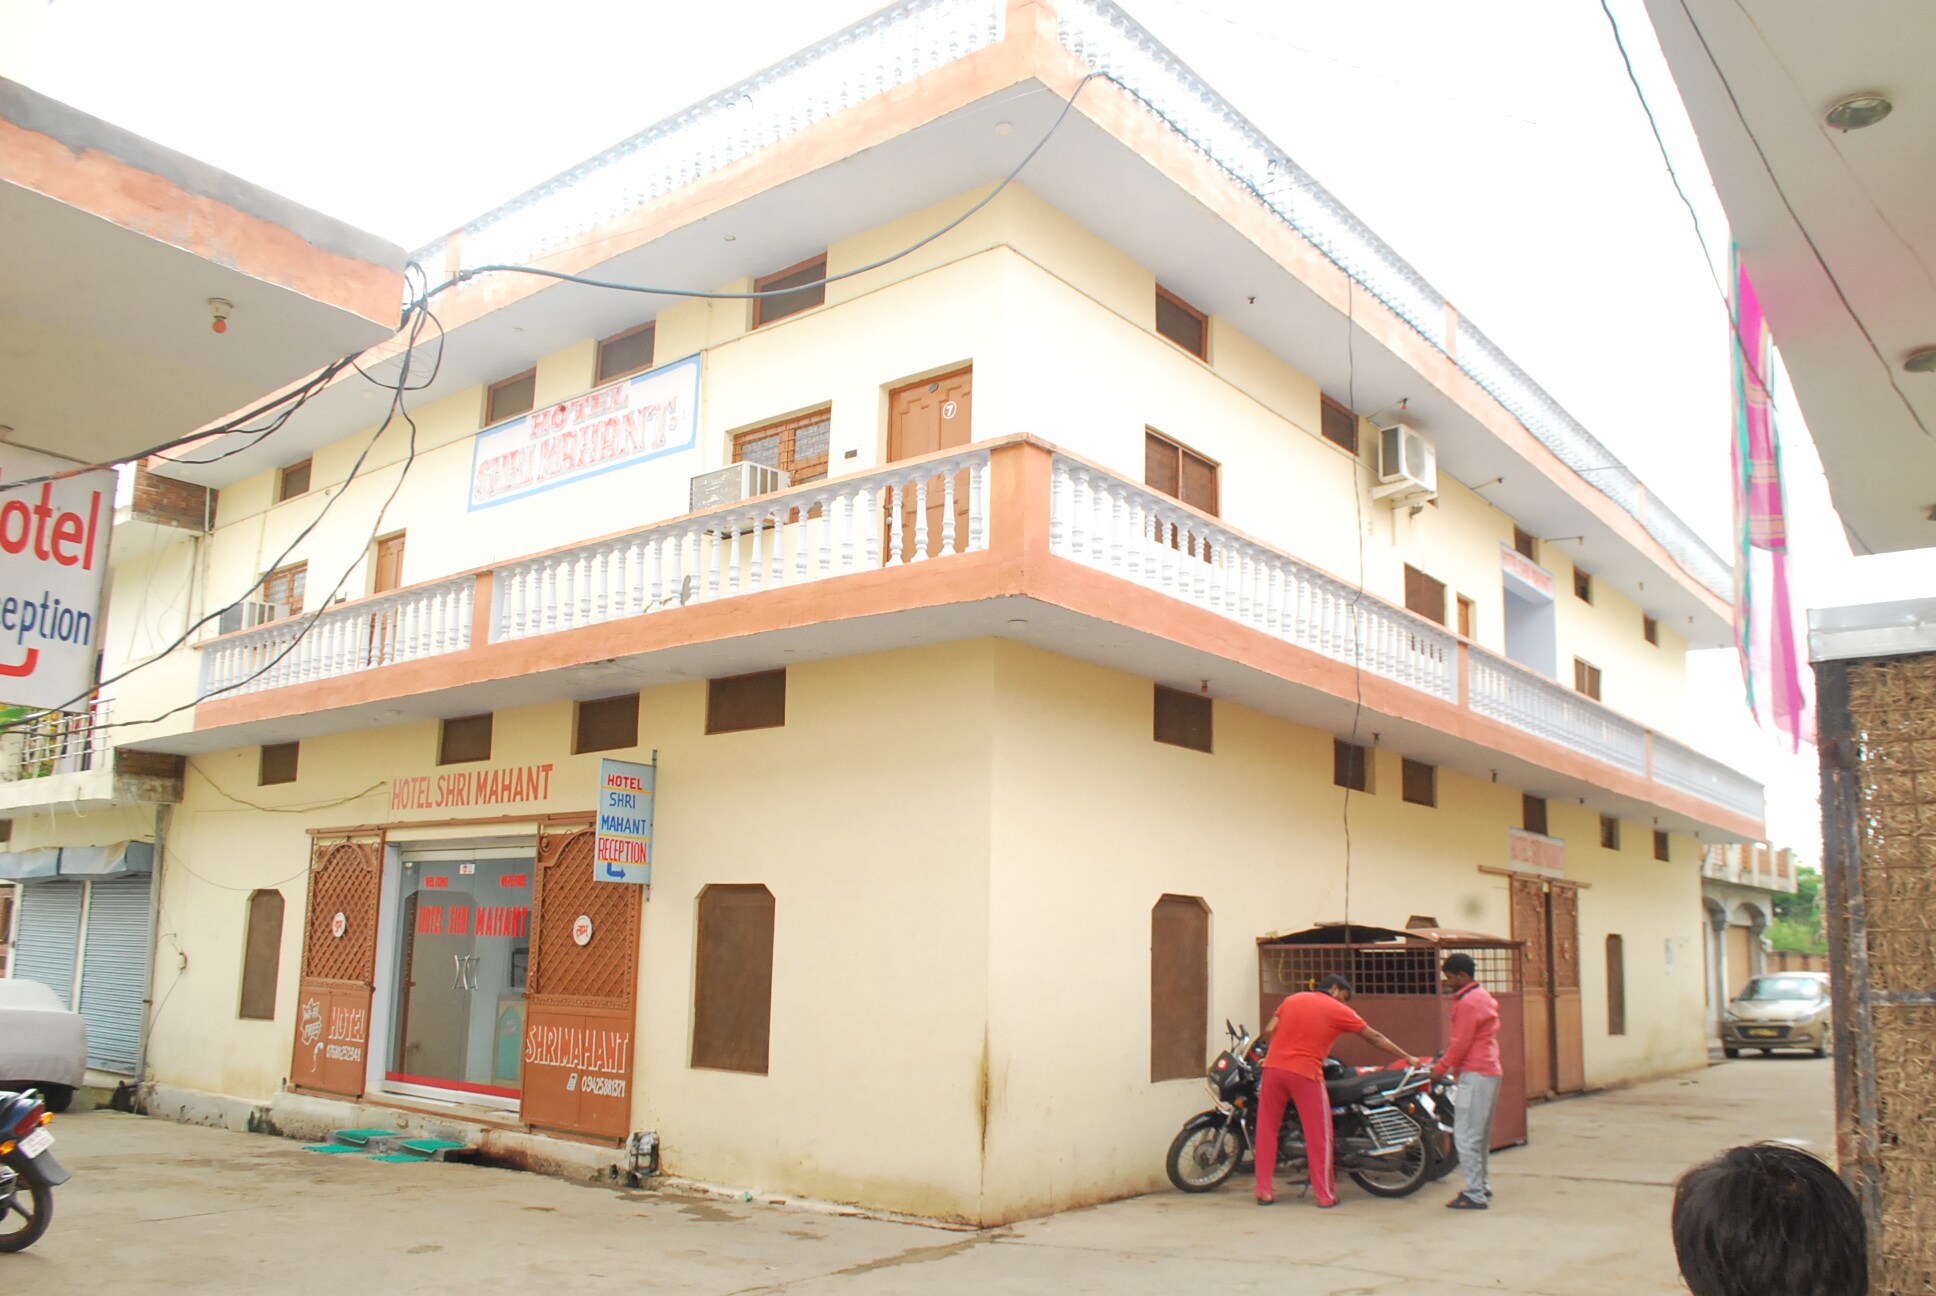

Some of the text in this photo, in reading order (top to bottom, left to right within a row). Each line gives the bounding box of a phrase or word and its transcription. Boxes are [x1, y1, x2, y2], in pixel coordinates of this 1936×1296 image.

[530, 385, 629, 440] HOTEL
[945, 404, 954, 417] 7
[474, 444, 535, 502] SHRI
[0, 467, 101, 570] otel
[0, 591, 91, 646] eption
[391, 763, 554, 810] HOTEL SHRI MAHANT
[607, 774, 643, 791] HOTEL
[609, 792, 636, 809] SHRI
[601, 815, 647, 835] MAHANT
[598, 838, 647, 863] RECEPTION
[417, 906, 444, 934] HOTEL
[475, 906, 528, 937] MAHANT
[328, 1007, 365, 1042] HOTEL
